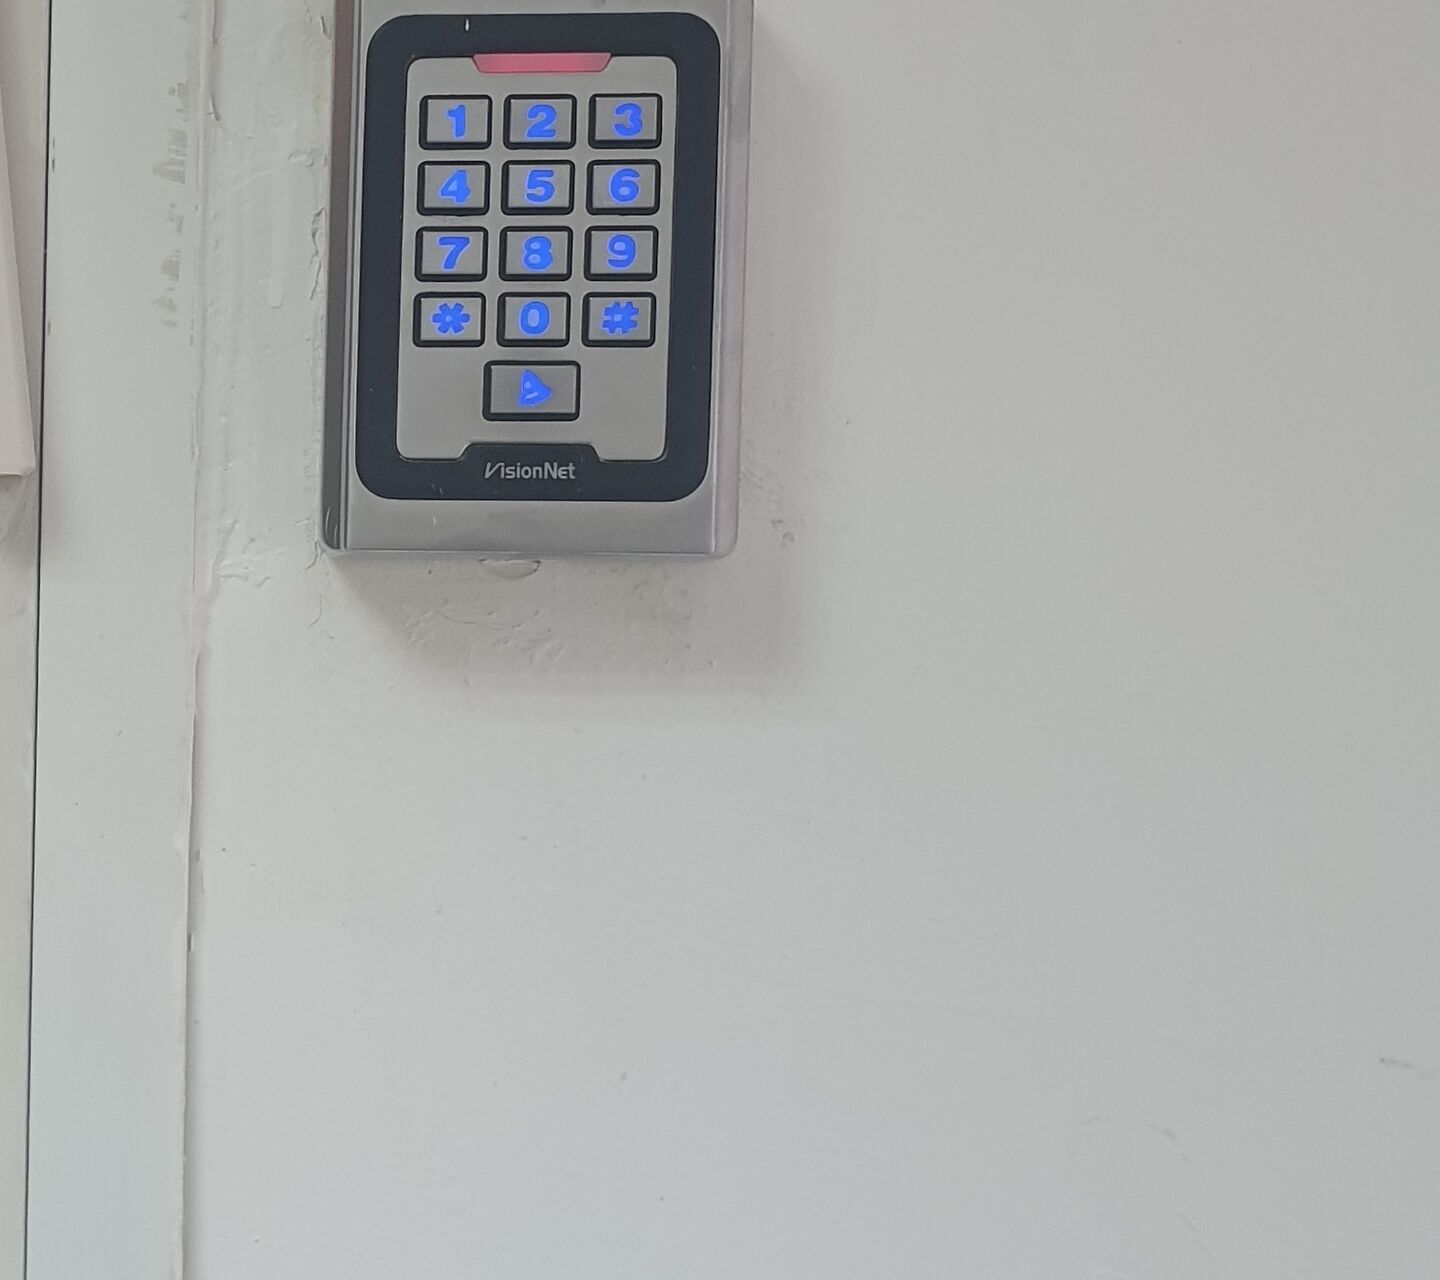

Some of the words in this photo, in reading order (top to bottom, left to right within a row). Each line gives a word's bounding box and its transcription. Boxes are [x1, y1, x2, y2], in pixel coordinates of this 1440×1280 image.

[446, 105, 466, 139] 1
[526, 104, 557, 140] 2
[613, 103, 643, 138] 3
[438, 170, 471, 205] 4
[525, 169, 555, 204] 5
[608, 168, 640, 204] 6
[437, 236, 469, 271] 7
[522, 235, 553, 272] 8
[607, 234, 636, 270] 9
[518, 301, 550, 337] 0
[601, 302, 639, 335] #
[484, 460, 577, 480] VisionNet
